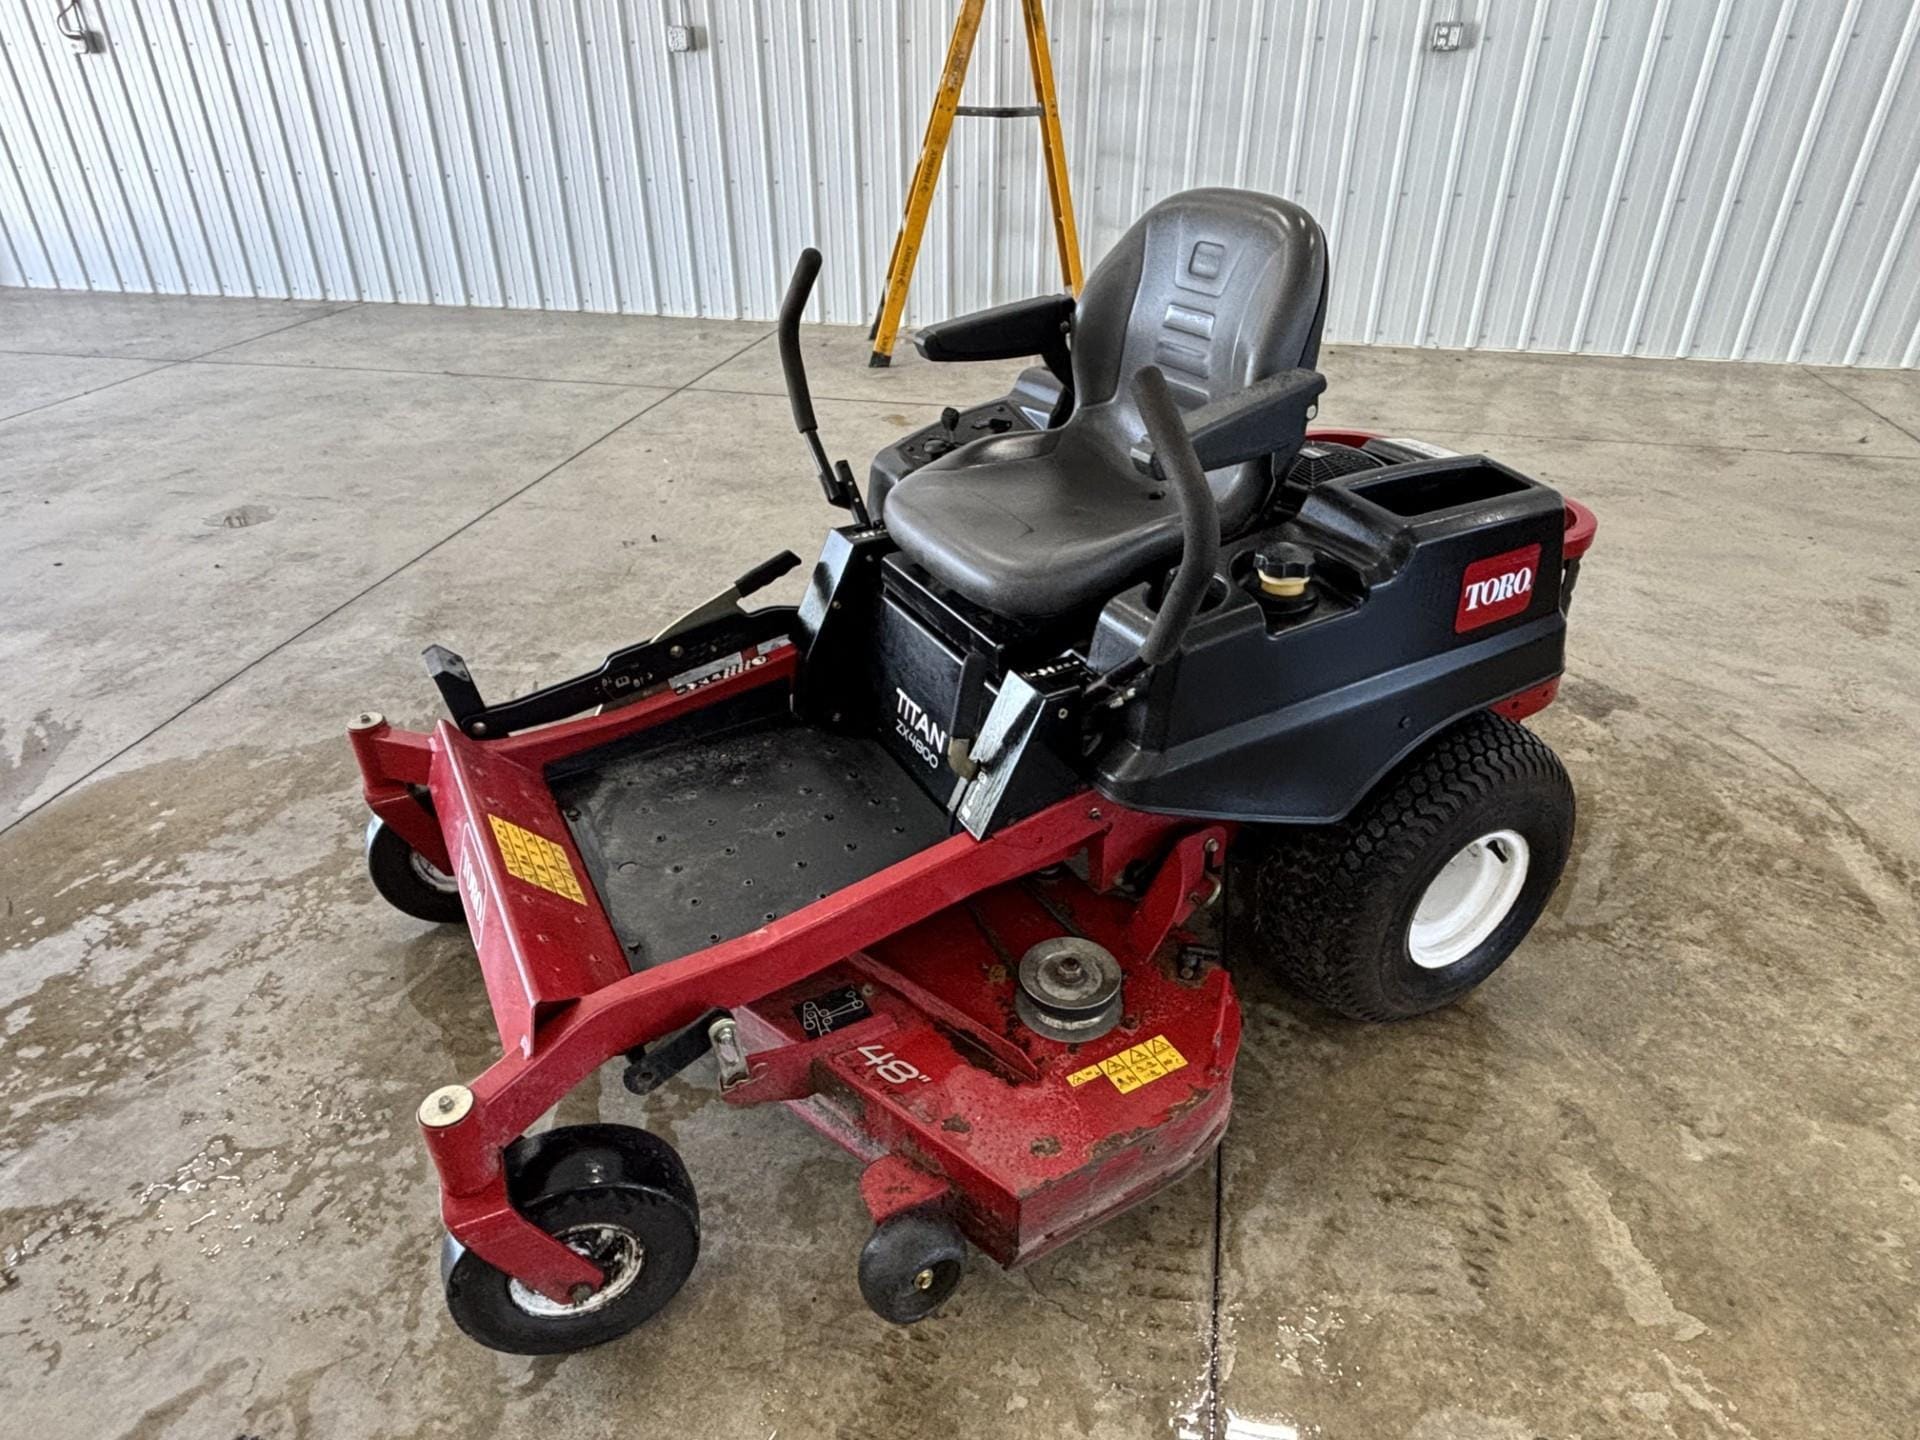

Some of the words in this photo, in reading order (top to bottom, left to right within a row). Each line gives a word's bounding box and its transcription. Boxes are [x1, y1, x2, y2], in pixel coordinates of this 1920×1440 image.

[1465, 567, 1532, 611] TORO
[895, 718, 939, 769] ZX4800
[896, 687, 947, 754] TITAN
[857, 1044, 932, 1084] 48"
